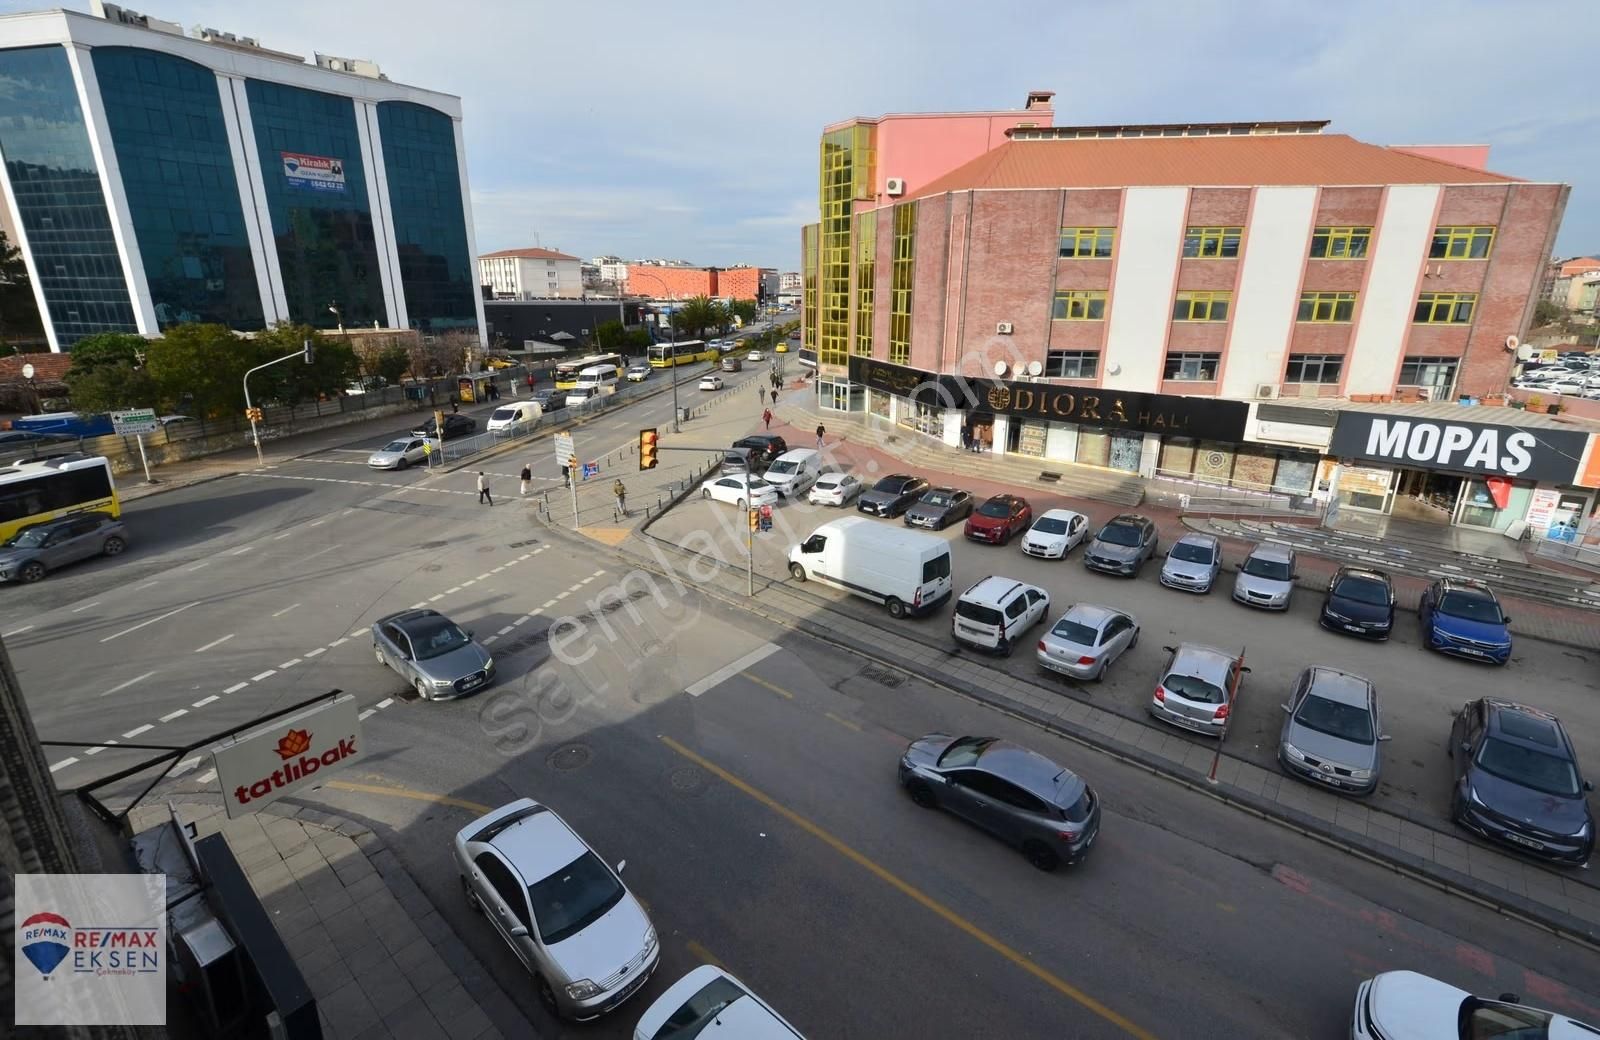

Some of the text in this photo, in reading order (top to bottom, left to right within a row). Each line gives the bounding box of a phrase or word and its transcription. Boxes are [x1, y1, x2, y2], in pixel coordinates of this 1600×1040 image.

[1013, 388, 1129, 423] DIORA
[1365, 418, 1537, 476] MOPAŞ
[234, 738, 358, 804] tatlıbak
